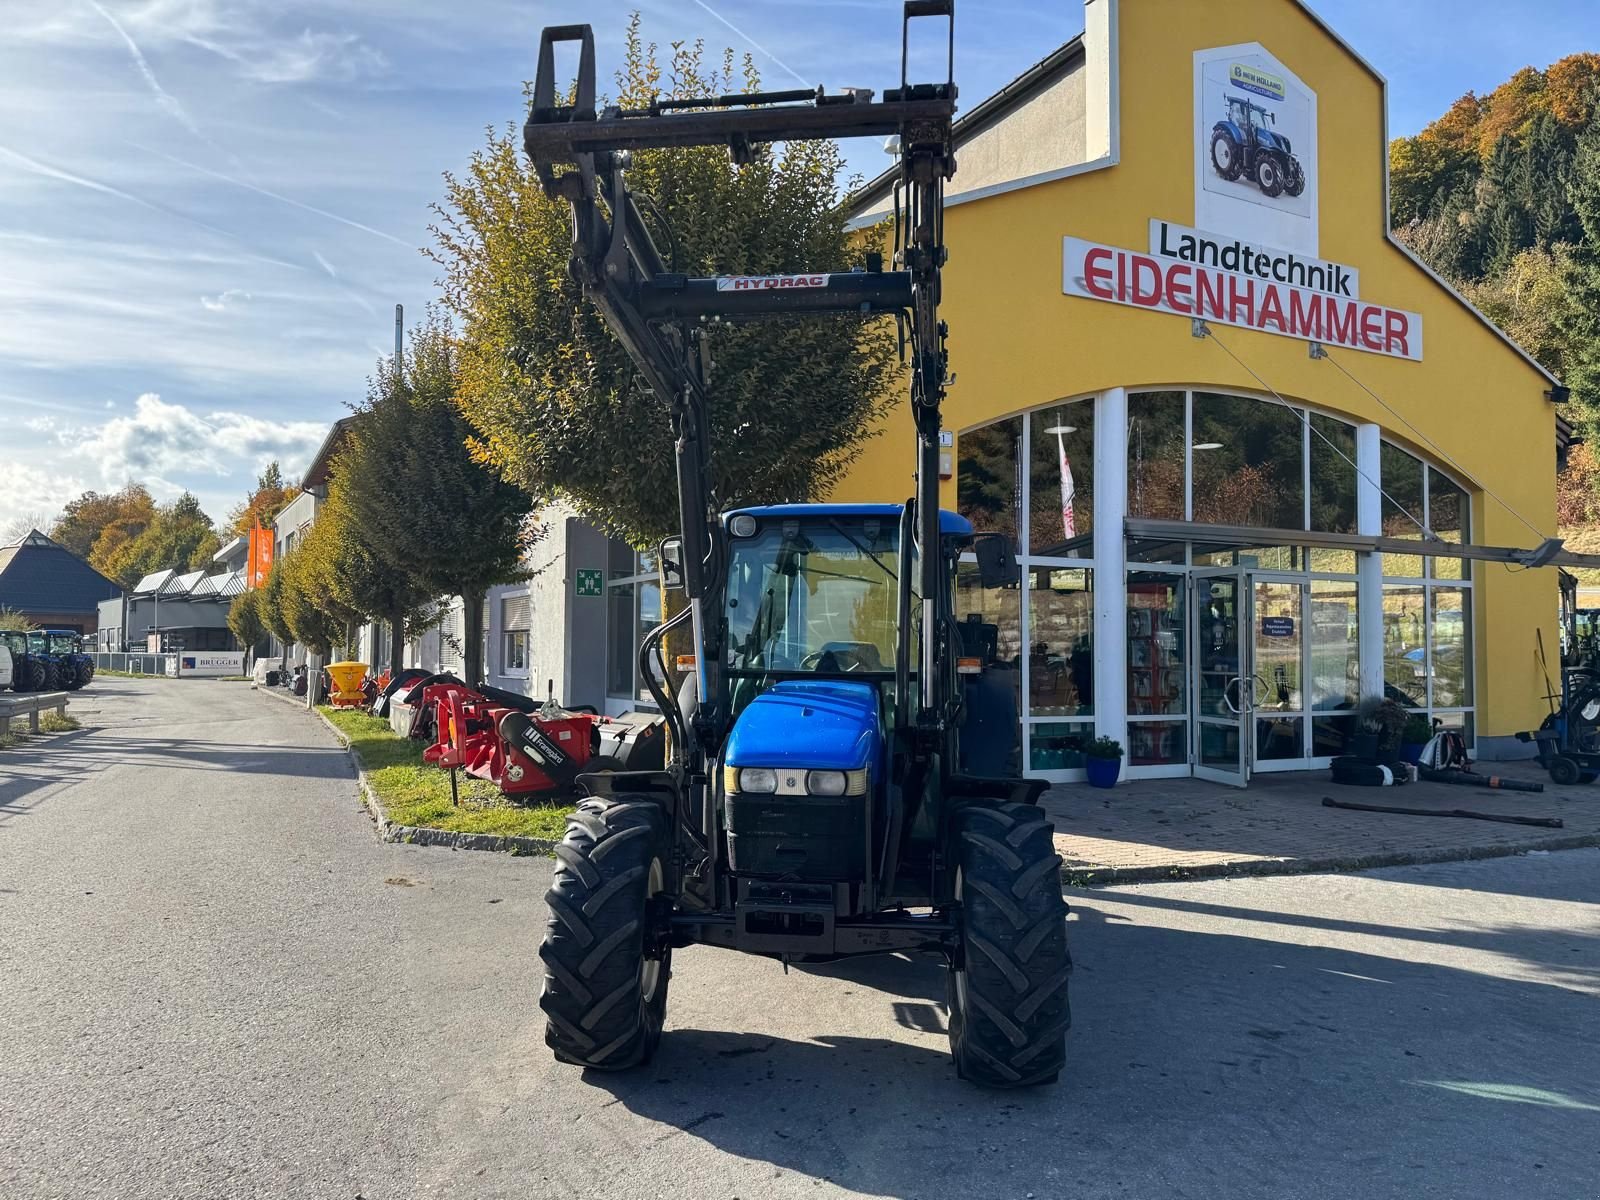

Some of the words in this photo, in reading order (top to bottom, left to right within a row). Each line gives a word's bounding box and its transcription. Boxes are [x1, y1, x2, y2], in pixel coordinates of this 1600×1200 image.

[1256, 75, 1282, 90] HOLLAND
[1160, 223, 1351, 297] Landtechnik
[1084, 247, 1409, 355] EIDENHAMMER
